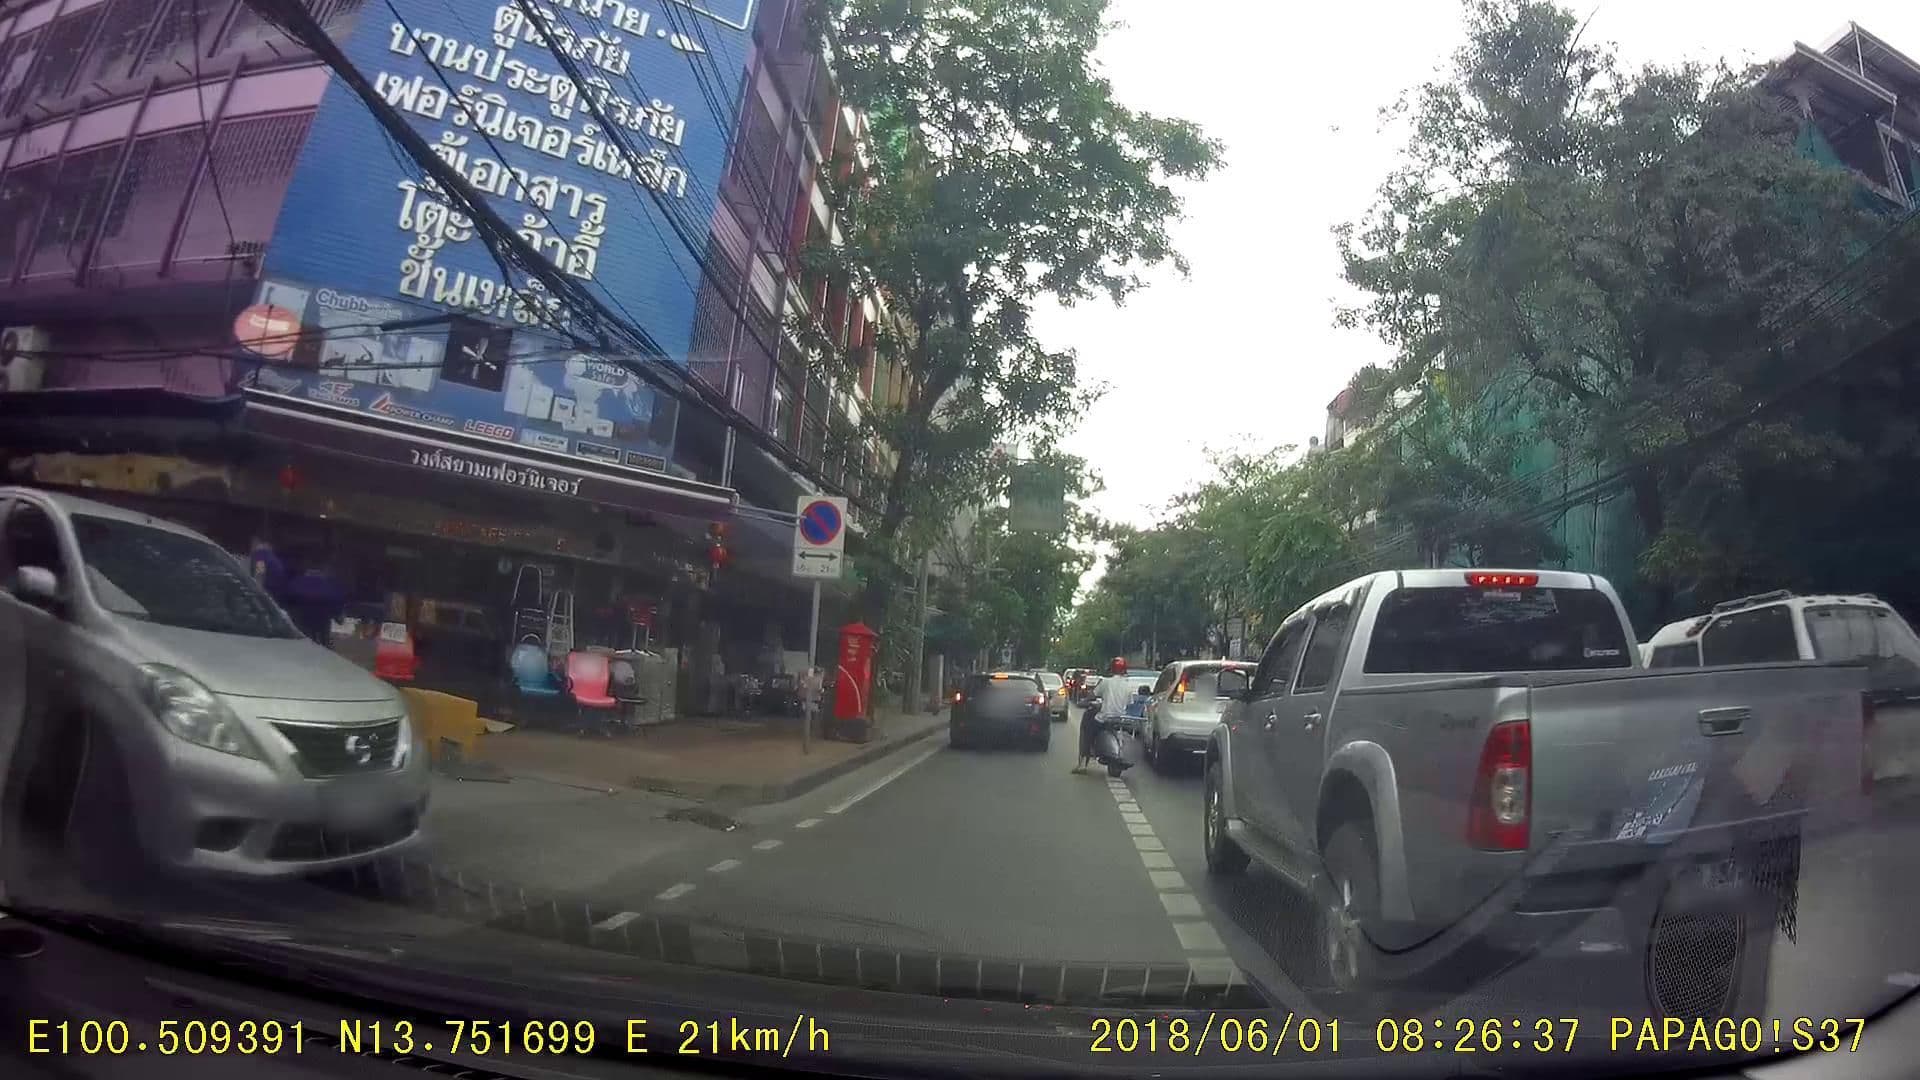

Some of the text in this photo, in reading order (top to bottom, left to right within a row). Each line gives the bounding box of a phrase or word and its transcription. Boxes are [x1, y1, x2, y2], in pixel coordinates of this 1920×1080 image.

[429, 131, 609, 223] ต้เอกสาร
[316, 288, 369, 312] Chubb
